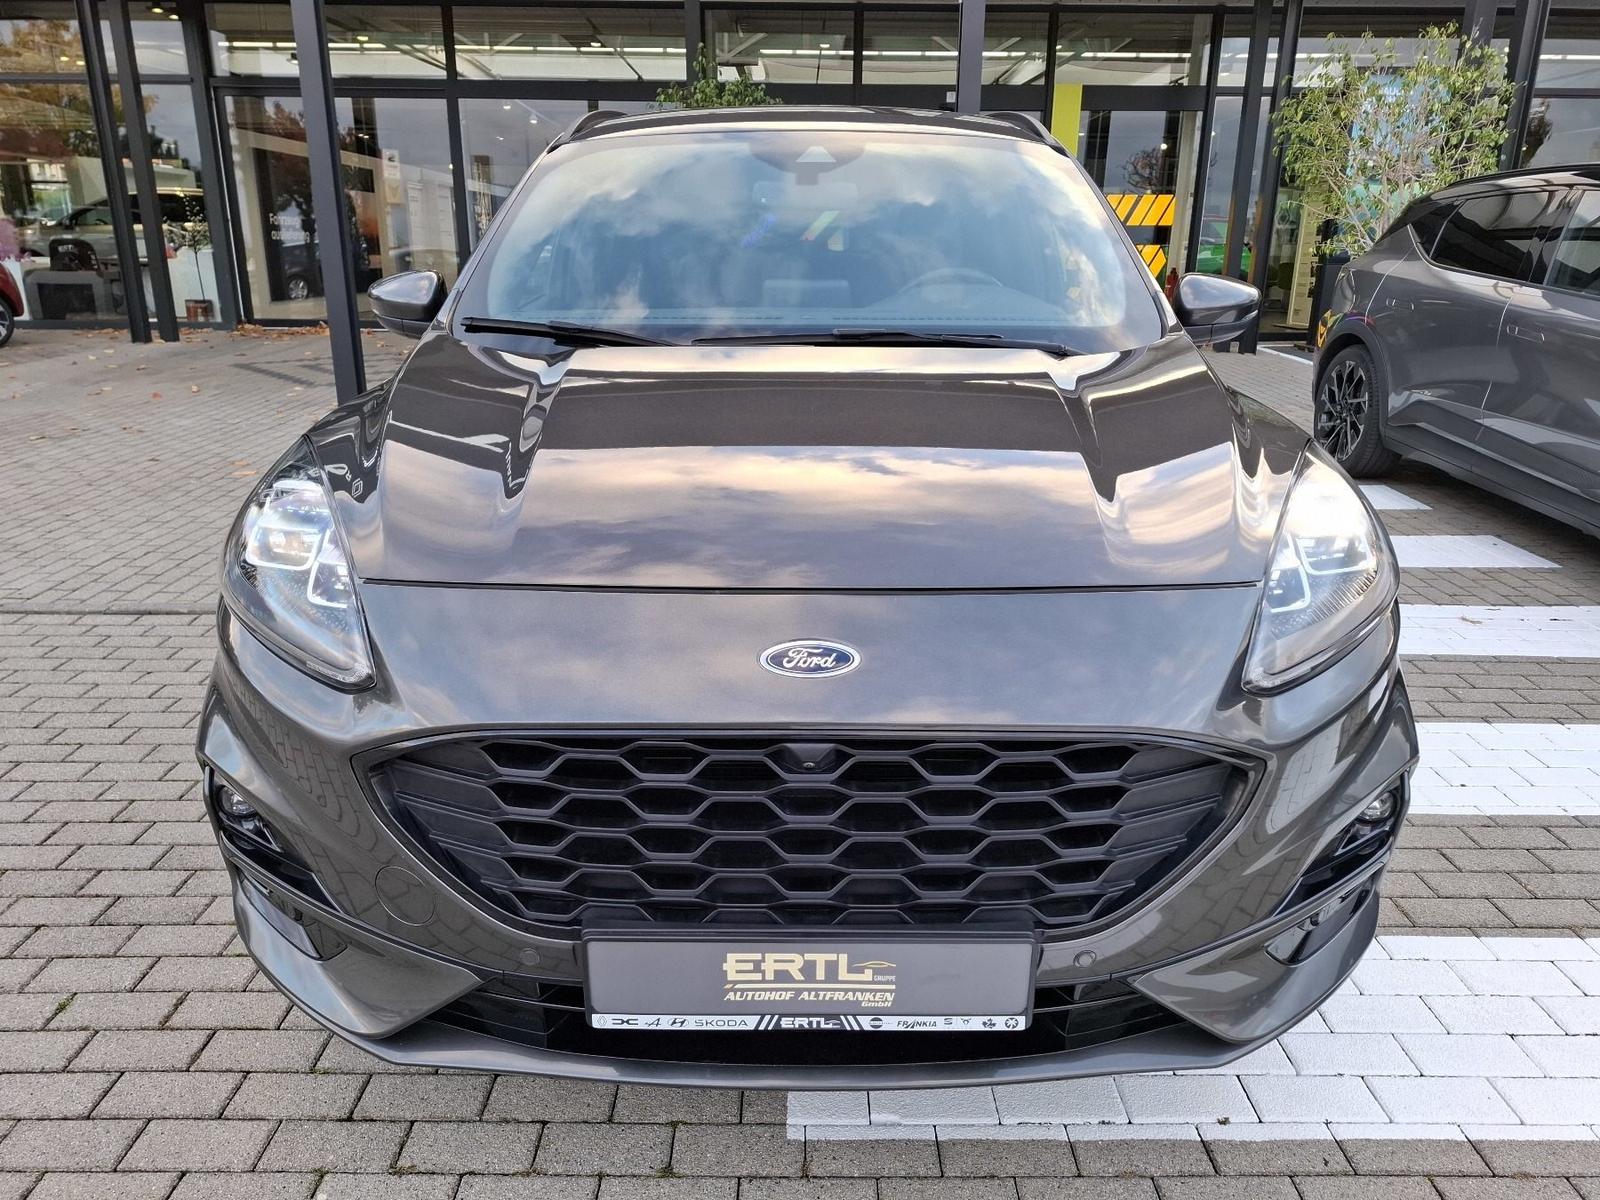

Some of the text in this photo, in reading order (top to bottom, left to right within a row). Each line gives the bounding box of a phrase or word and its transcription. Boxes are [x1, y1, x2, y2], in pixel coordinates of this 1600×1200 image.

[782, 647, 837, 668] Ford
[722, 953, 873, 981] ERTL
[723, 991, 896, 1001] AUTOHOF ALTFRANKEN
[780, 1017, 833, 1028] ERTL
